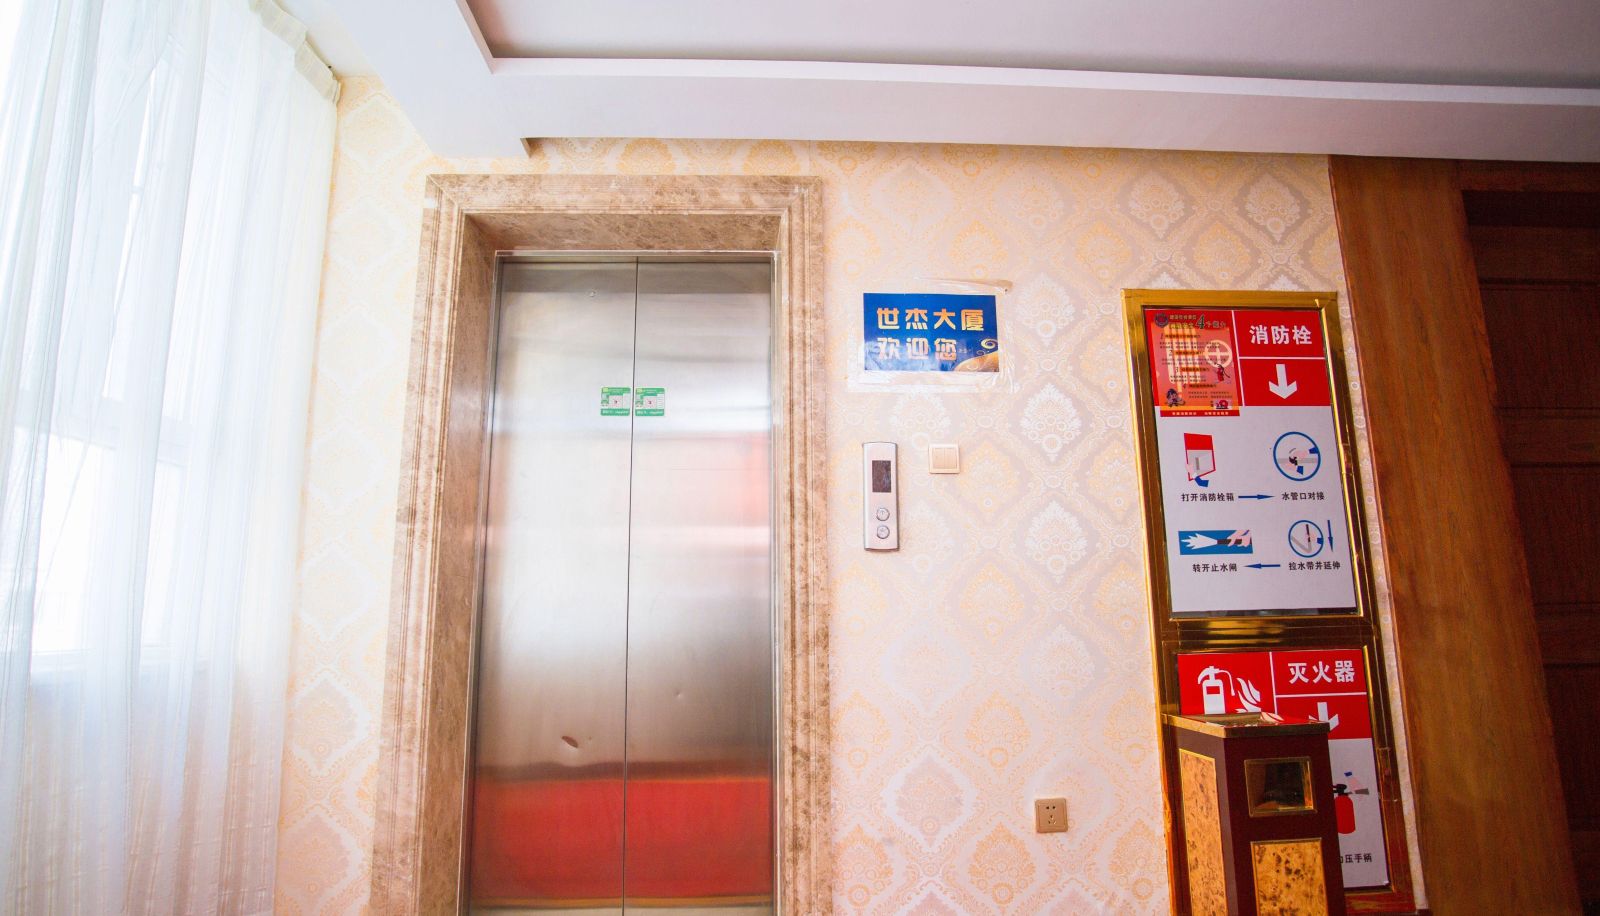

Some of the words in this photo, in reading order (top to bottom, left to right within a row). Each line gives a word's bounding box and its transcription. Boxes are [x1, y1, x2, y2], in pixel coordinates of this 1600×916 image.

[877, 307, 984, 331] 世杰大厦
[1249, 325, 1313, 345] 消防栓
[877, 337, 957, 361] 欢迎您
[1181, 492, 1235, 502] 打开消防栓箱
[1281, 491, 1325, 501] 水管口对接
[1192, 563, 1238, 573] 转开止水闸
[1288, 561, 1341, 571] 拉水带并延伸
[1288, 660, 1355, 684] 灭火器
